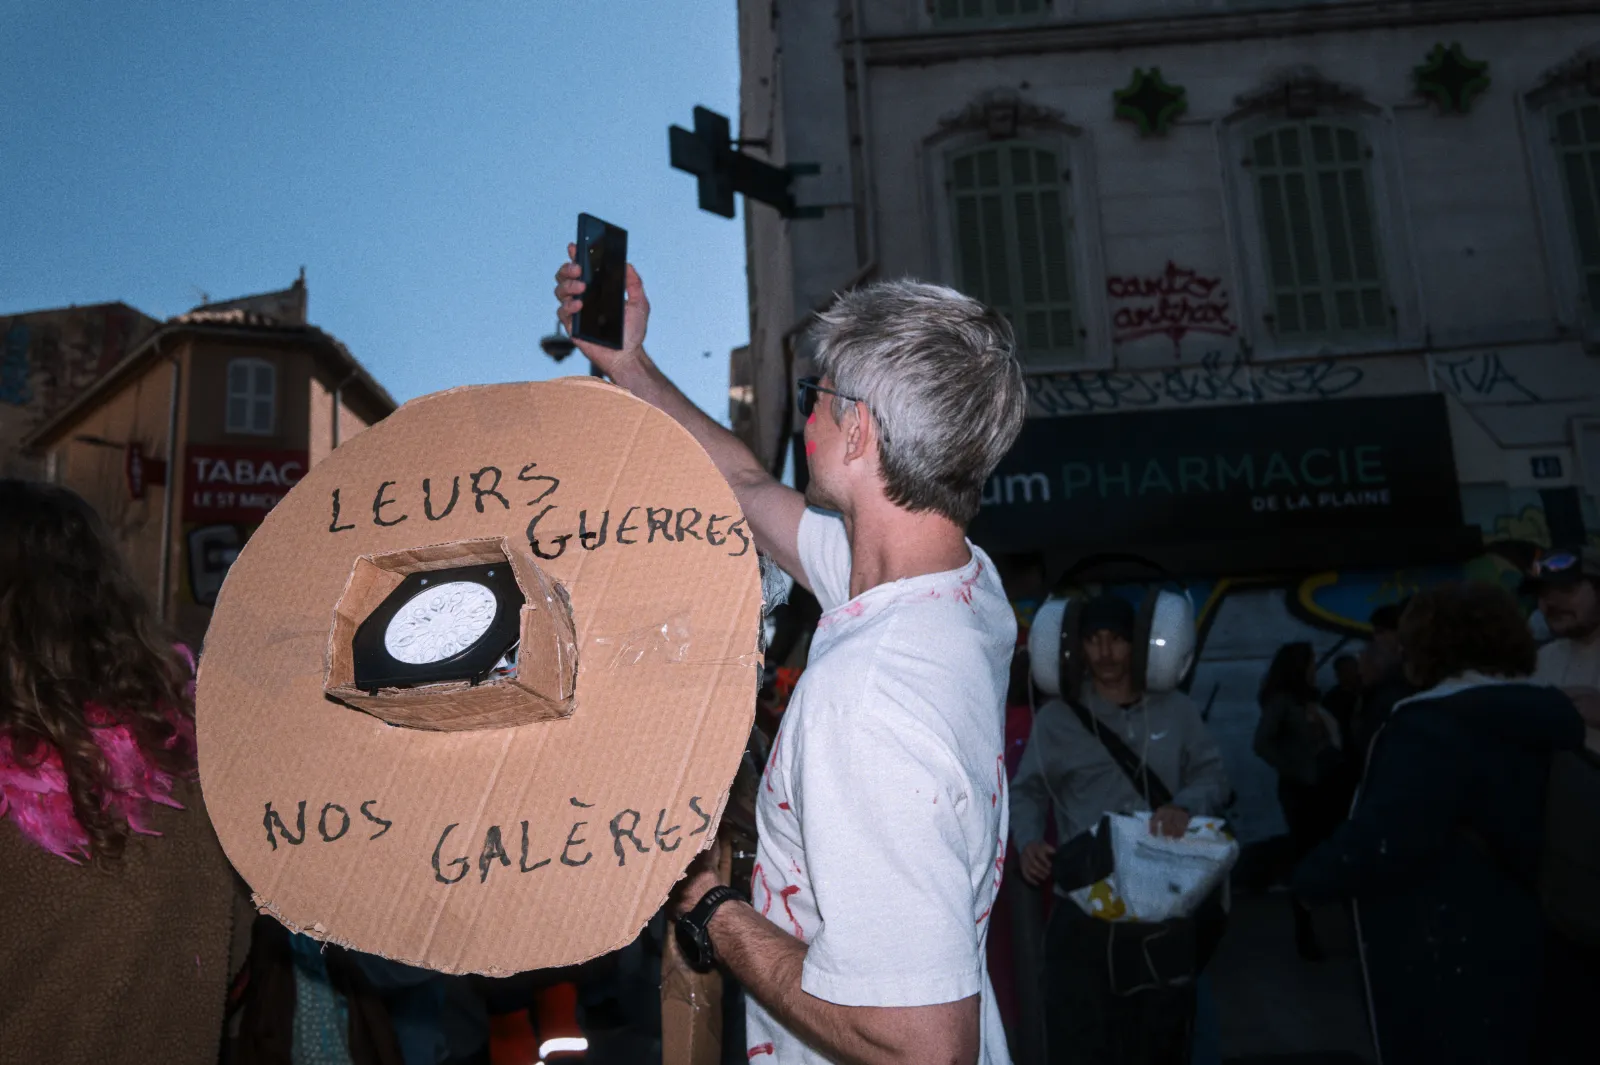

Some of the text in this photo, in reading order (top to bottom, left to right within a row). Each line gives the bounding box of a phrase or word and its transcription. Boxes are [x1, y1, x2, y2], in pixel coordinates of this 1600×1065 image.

[191, 456, 302, 487] TABAC
[1061, 444, 1388, 500] PHARMACIE
[192, 490, 213, 508] LE
[216, 491, 236, 508] ST
[328, 463, 752, 560] LEURS GUERRES
[1251, 488, 1392, 512] DE LA PLAINE
[262, 796, 712, 886] NOS GALÈRES
